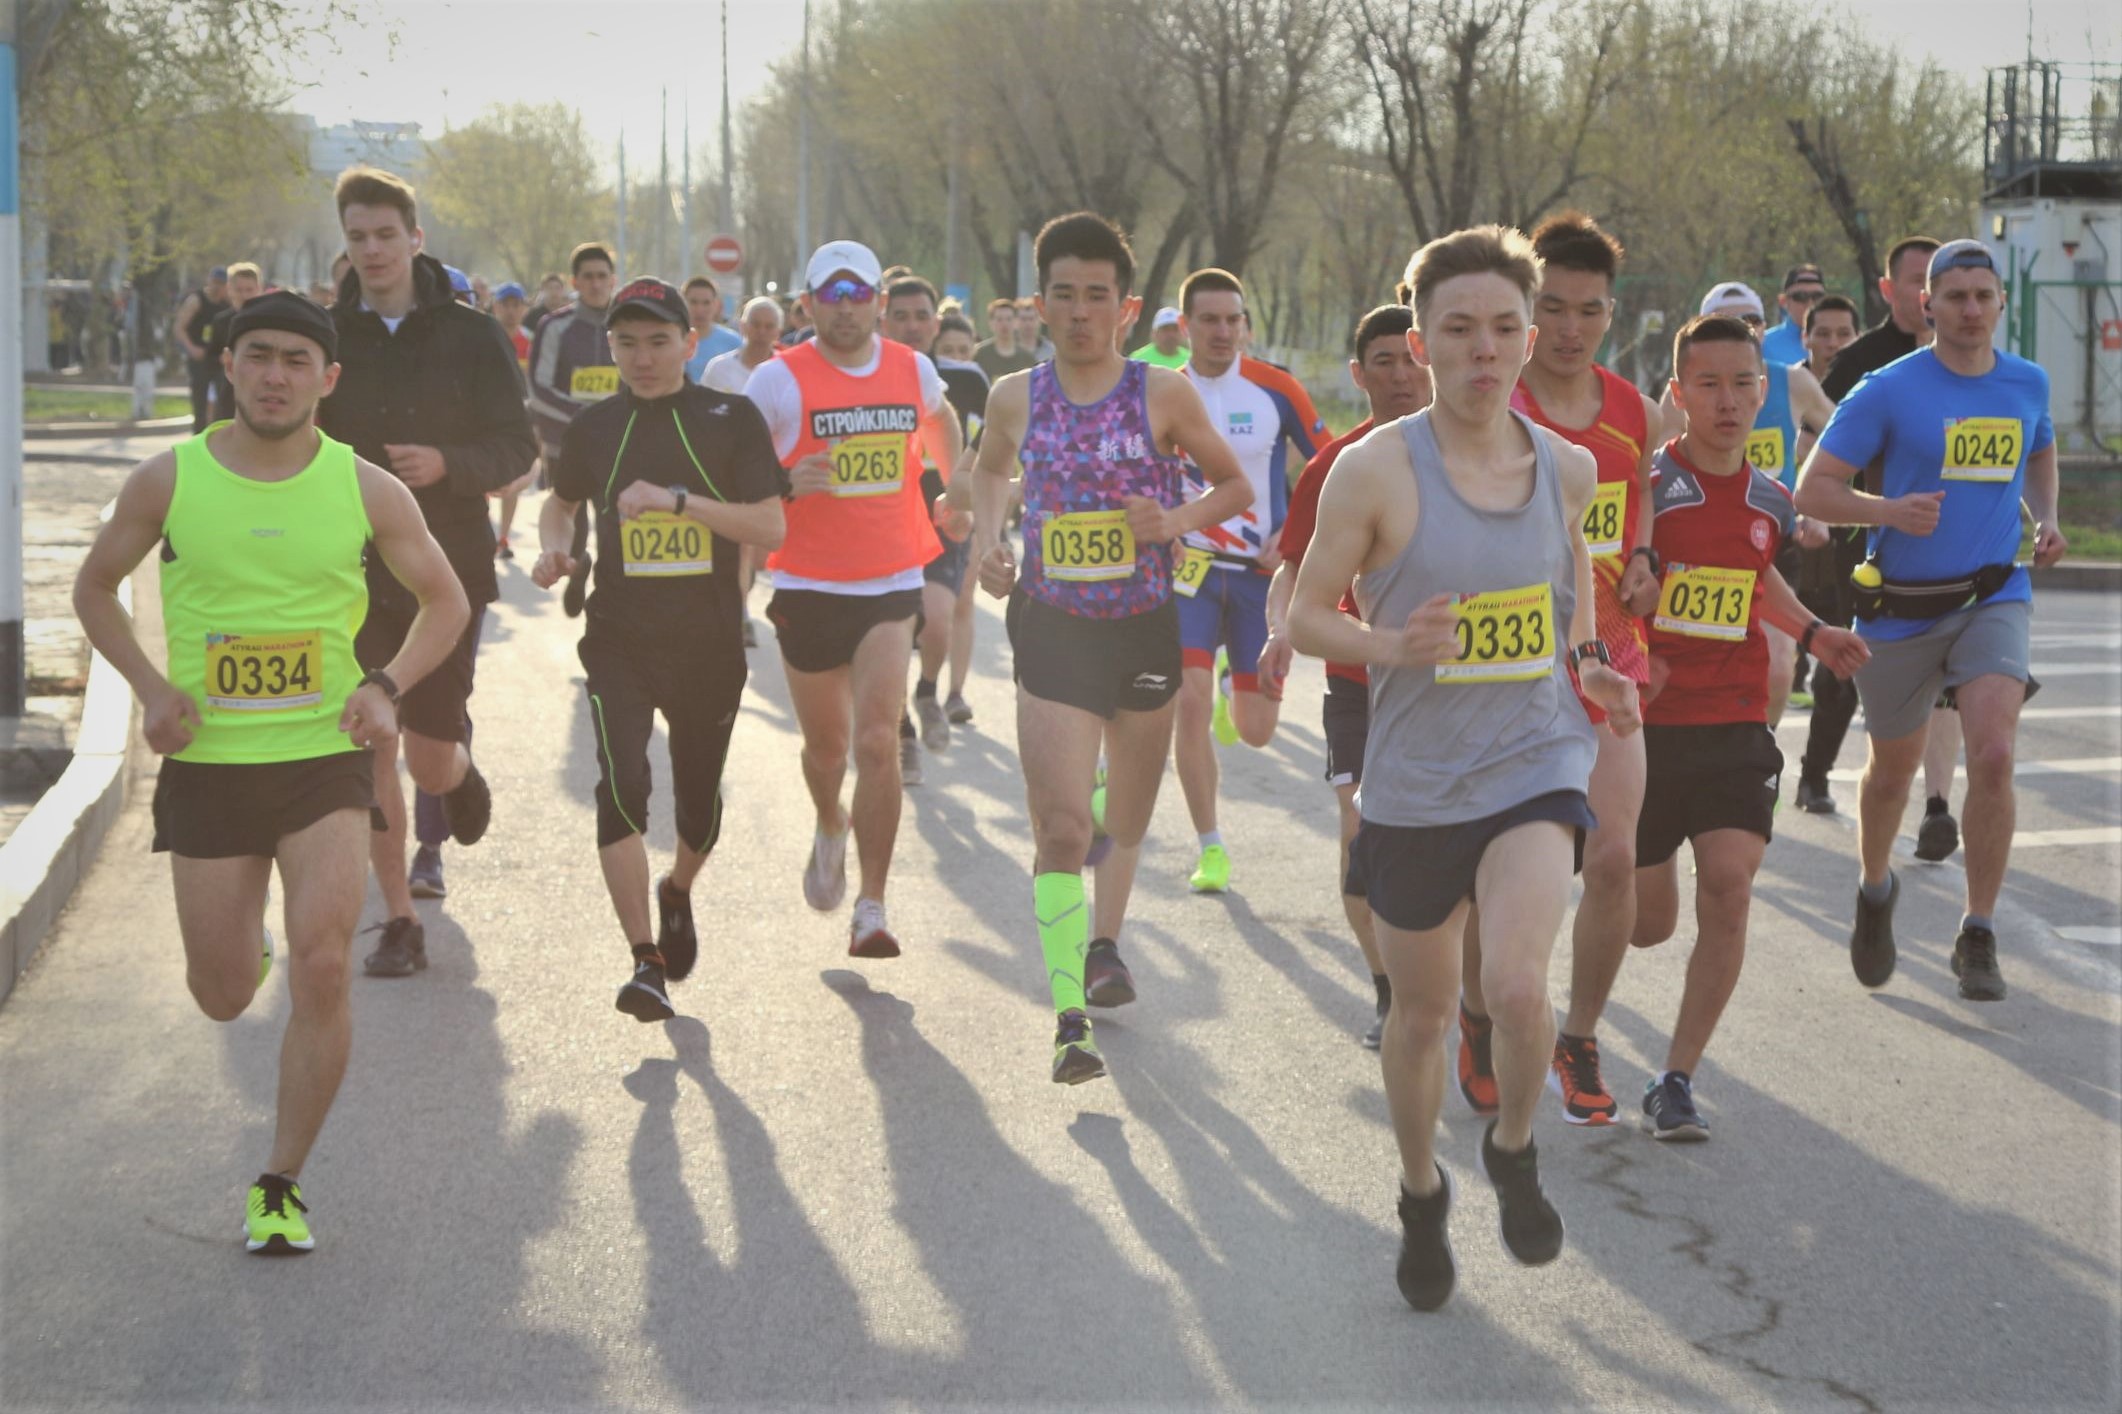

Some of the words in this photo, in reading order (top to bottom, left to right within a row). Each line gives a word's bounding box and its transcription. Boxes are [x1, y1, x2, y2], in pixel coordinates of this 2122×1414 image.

[812, 406, 916, 437] СТРОЙКЛАСС
[1229, 425, 1253, 435] KAZ
[837, 450, 899, 482] 0263
[1750, 442, 1776, 467] 53
[1954, 434, 2015, 466] 0242
[1583, 502, 1618, 540] 48
[630, 526, 701, 560] 0240
[1051, 528, 1125, 565] 0358
[1669, 582, 1745, 624] 0313
[1454, 610, 1545, 660] 0333
[217, 652, 311, 696] 0334
